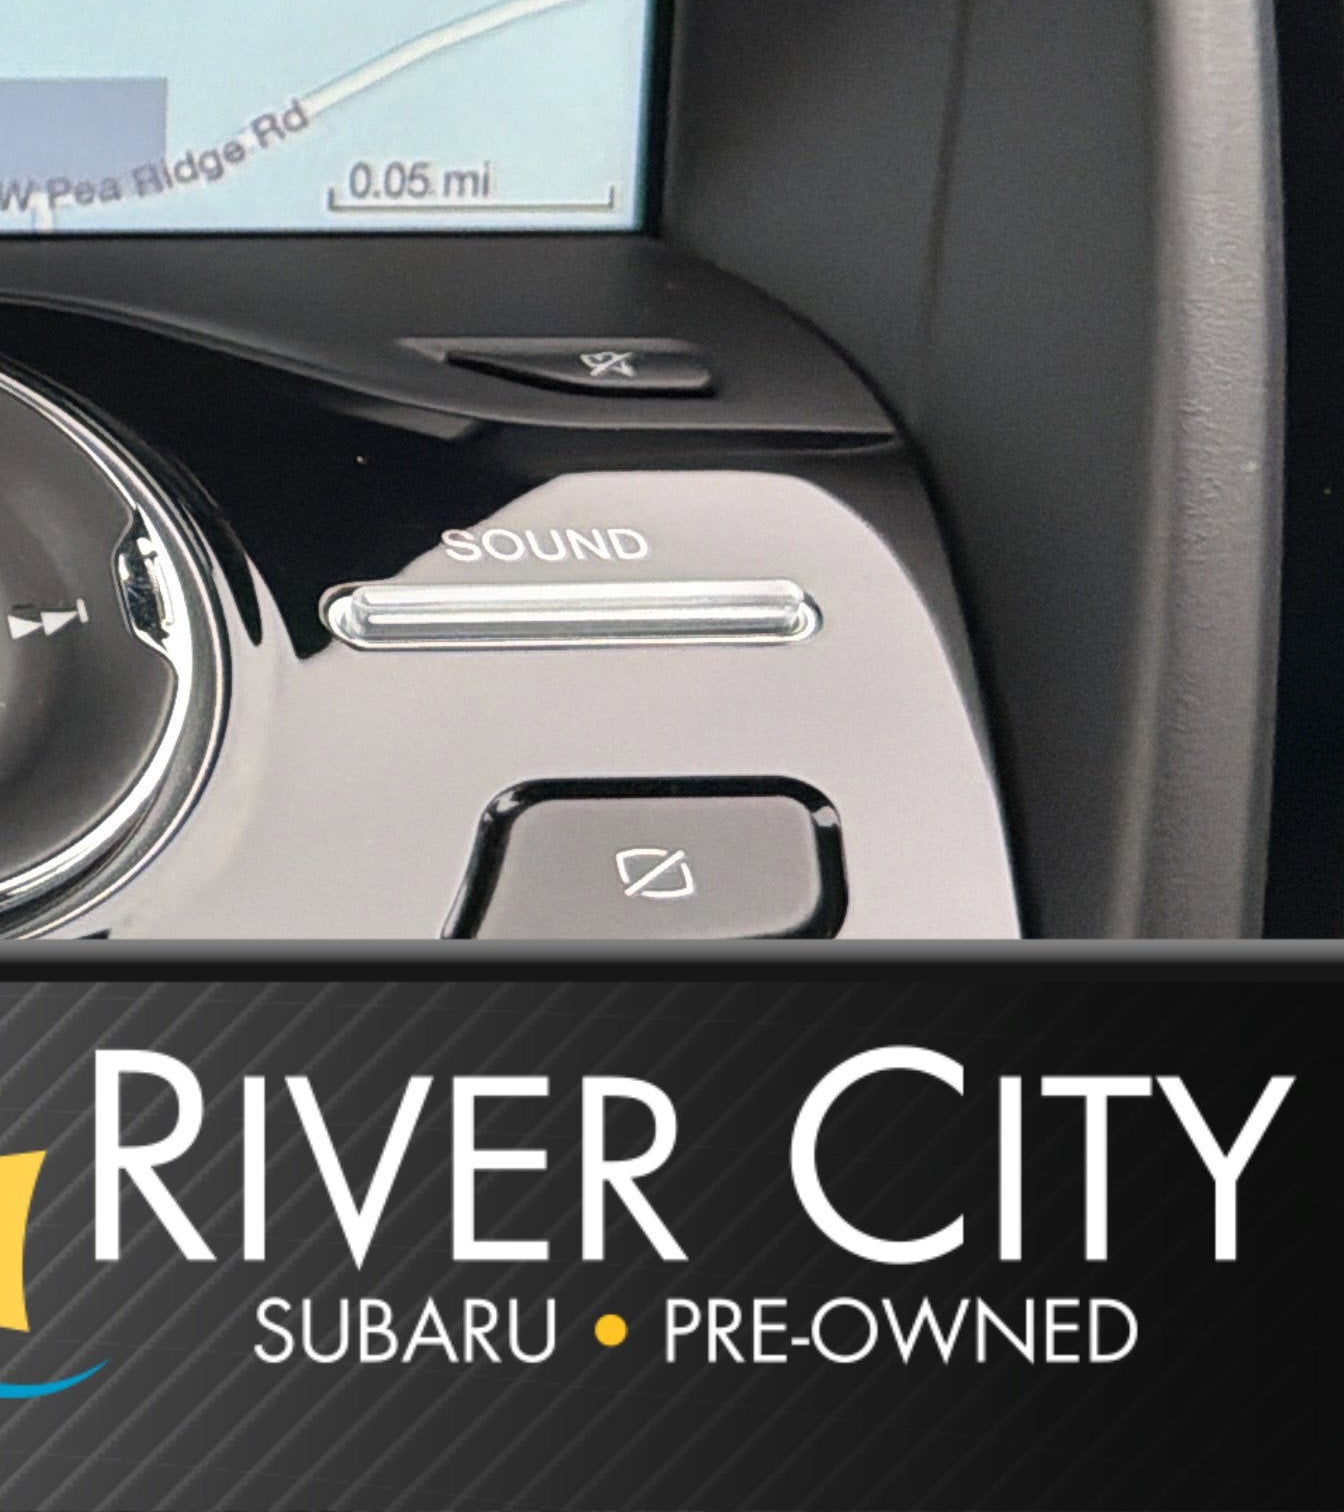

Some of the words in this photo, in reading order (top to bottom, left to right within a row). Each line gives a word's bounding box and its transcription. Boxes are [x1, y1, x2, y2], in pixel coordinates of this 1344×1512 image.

[46, 175, 123, 210] Pea
[132, 140, 247, 198] Ridge
[251, 97, 310, 149] Rd
[348, 162, 433, 200] 0.05
[443, 159, 492, 199] mi
[440, 527, 649, 563] SOUND
